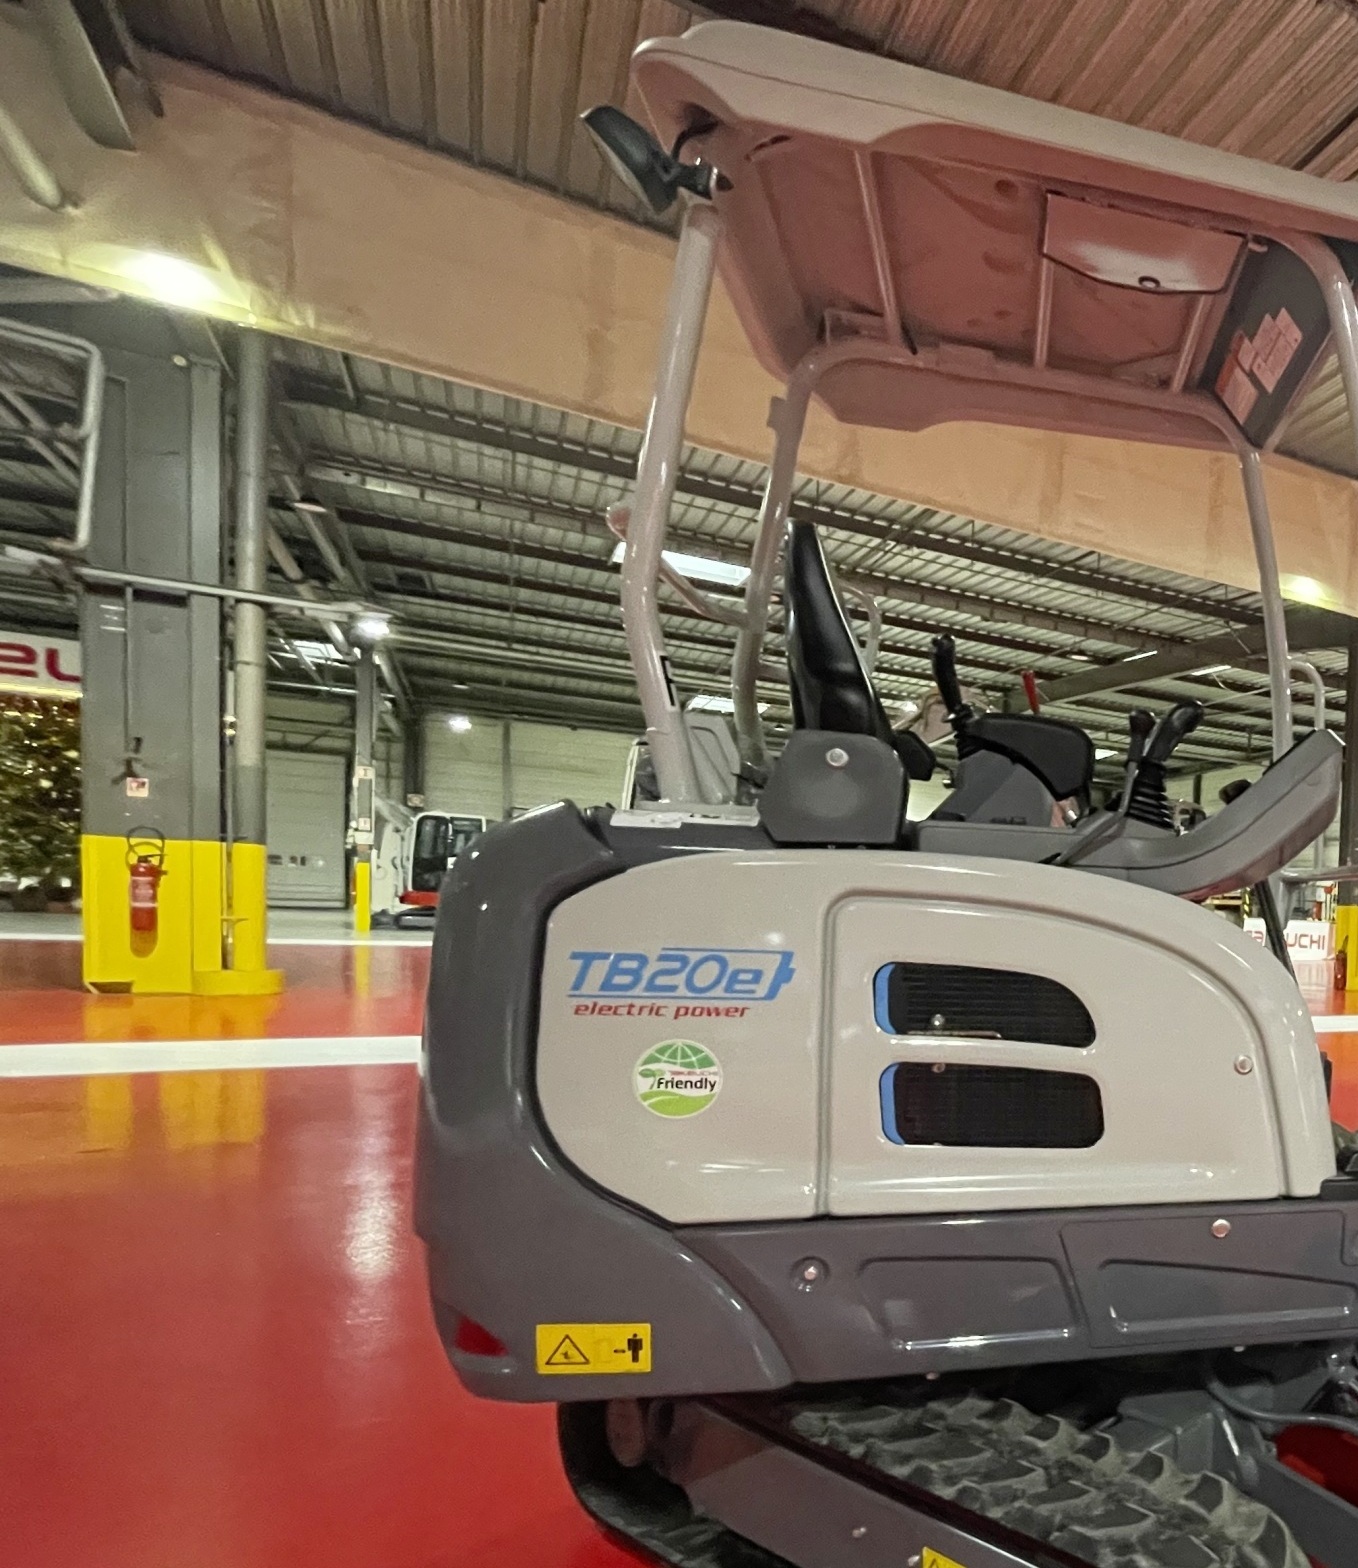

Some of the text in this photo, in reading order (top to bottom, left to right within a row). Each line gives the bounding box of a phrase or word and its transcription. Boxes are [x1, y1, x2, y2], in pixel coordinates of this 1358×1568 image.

[569, 951, 764, 994] TB20e
[573, 1001, 751, 1020] electric power
[656, 1077, 717, 1092] Friendly
